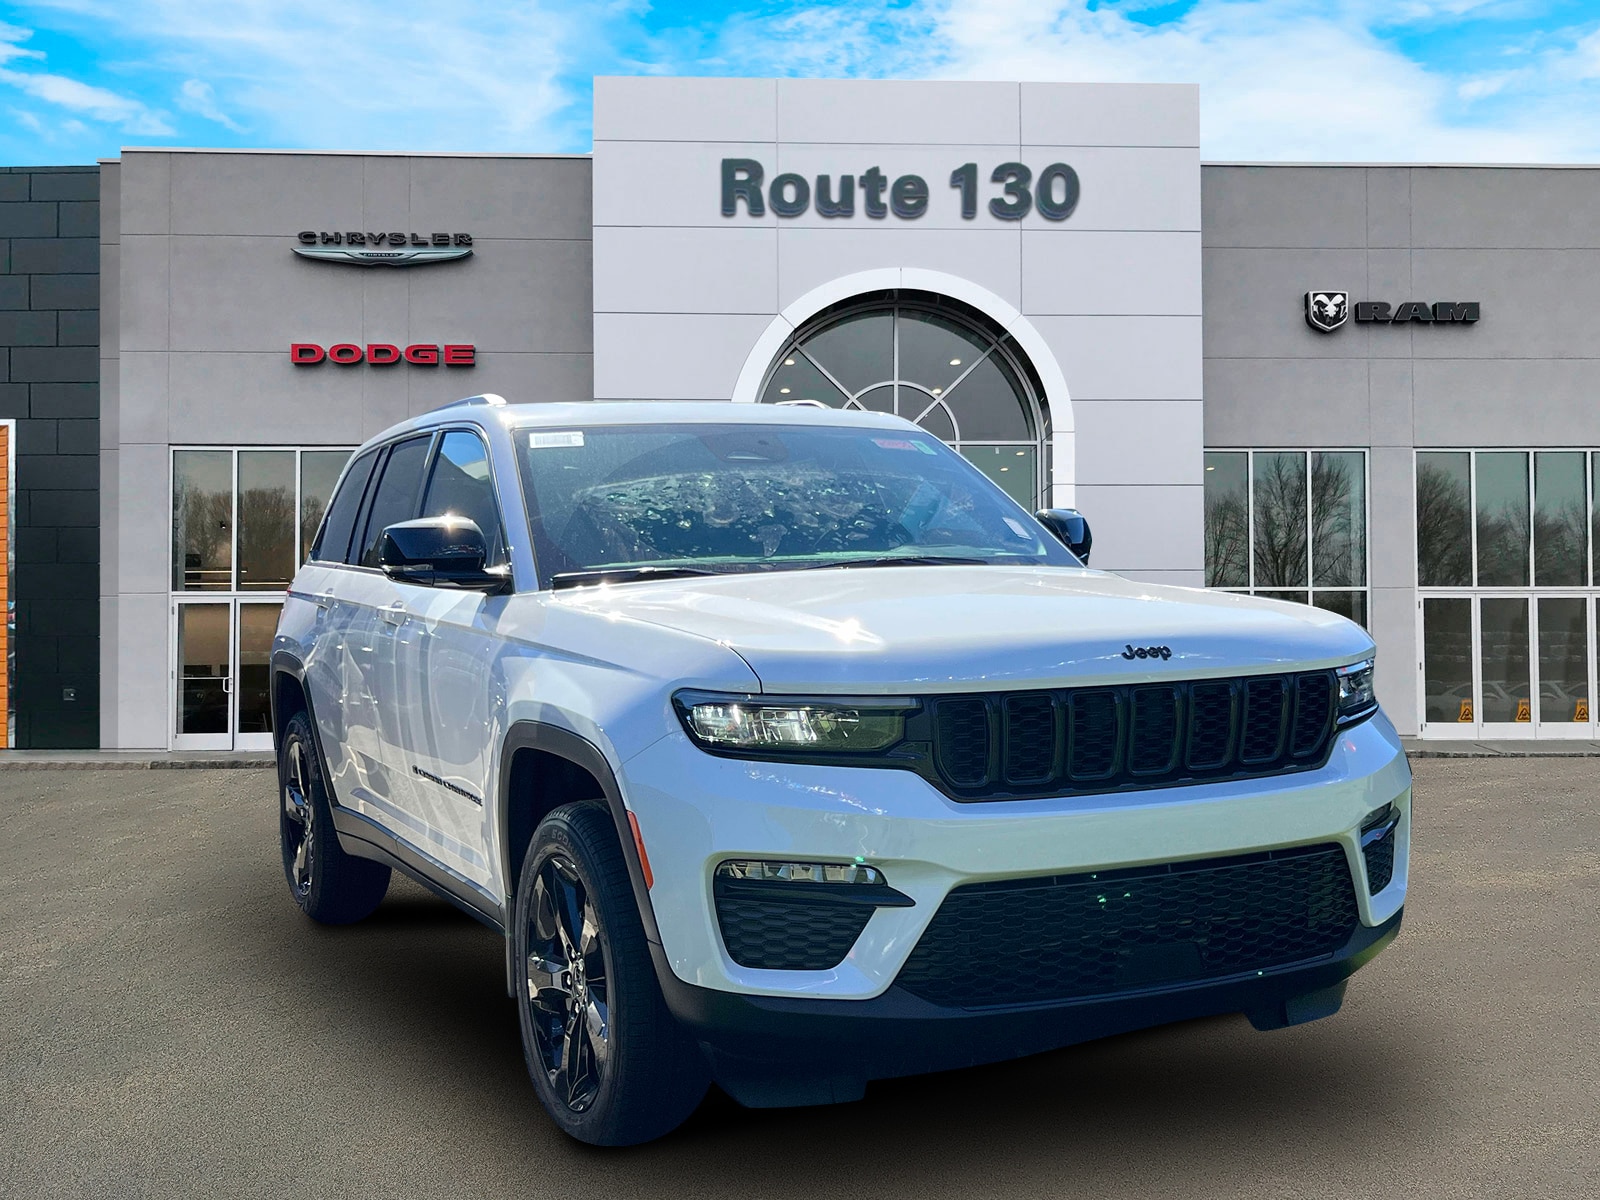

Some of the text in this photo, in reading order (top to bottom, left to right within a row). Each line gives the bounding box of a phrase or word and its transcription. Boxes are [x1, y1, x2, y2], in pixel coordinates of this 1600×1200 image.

[721, 157, 1080, 221] Route 130
[298, 231, 473, 246] CHRYSLER
[1354, 301, 1480, 323] RAM
[290, 343, 475, 366] DODGE
[1121, 644, 1172, 661] Jeep
